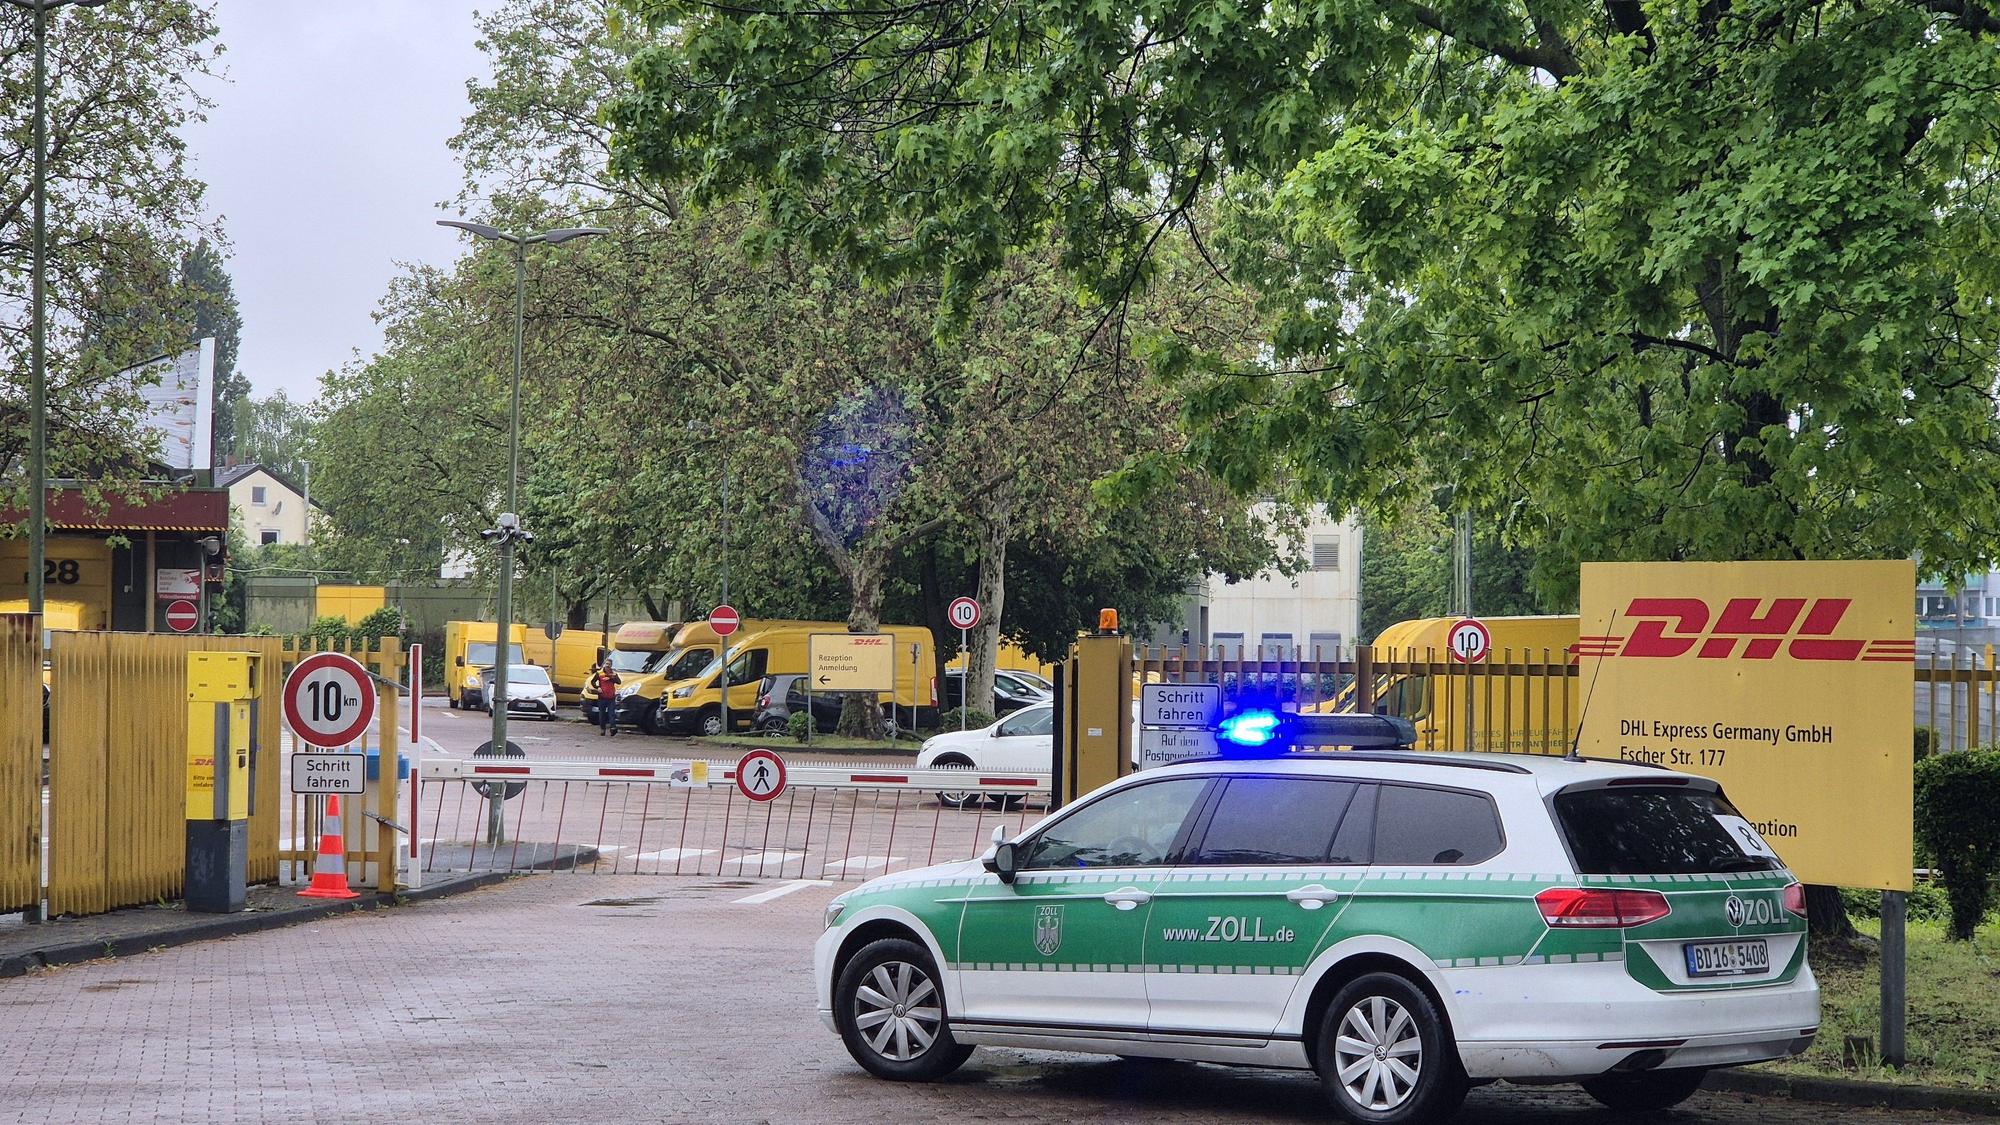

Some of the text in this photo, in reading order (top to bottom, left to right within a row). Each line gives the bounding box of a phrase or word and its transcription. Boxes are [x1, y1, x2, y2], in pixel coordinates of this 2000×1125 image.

[957, 607, 971, 620] 10
[1620, 598, 1867, 661] DHL
[1459, 632, 1478, 651] 10
[307, 681, 358, 721] 10 km
[1158, 691, 1204, 703] Schritt
[1158, 708, 1203, 720] fahren
[1161, 734, 1199, 746] Auf dem
[1620, 720, 1832, 745] DHL Express Germany GmbH
[1620, 746, 1726, 766] Escher Str. 177
[306, 760, 350, 772] Schritt
[307, 776, 350, 788] fahren
[1738, 826, 1762, 851] 8
[1040, 907, 1058, 916] ZOLL
[1744, 899, 1789, 925] ZOLL
[1163, 916, 1295, 942] www.ZOLL.de
[1737, 944, 1767, 967] 5408
